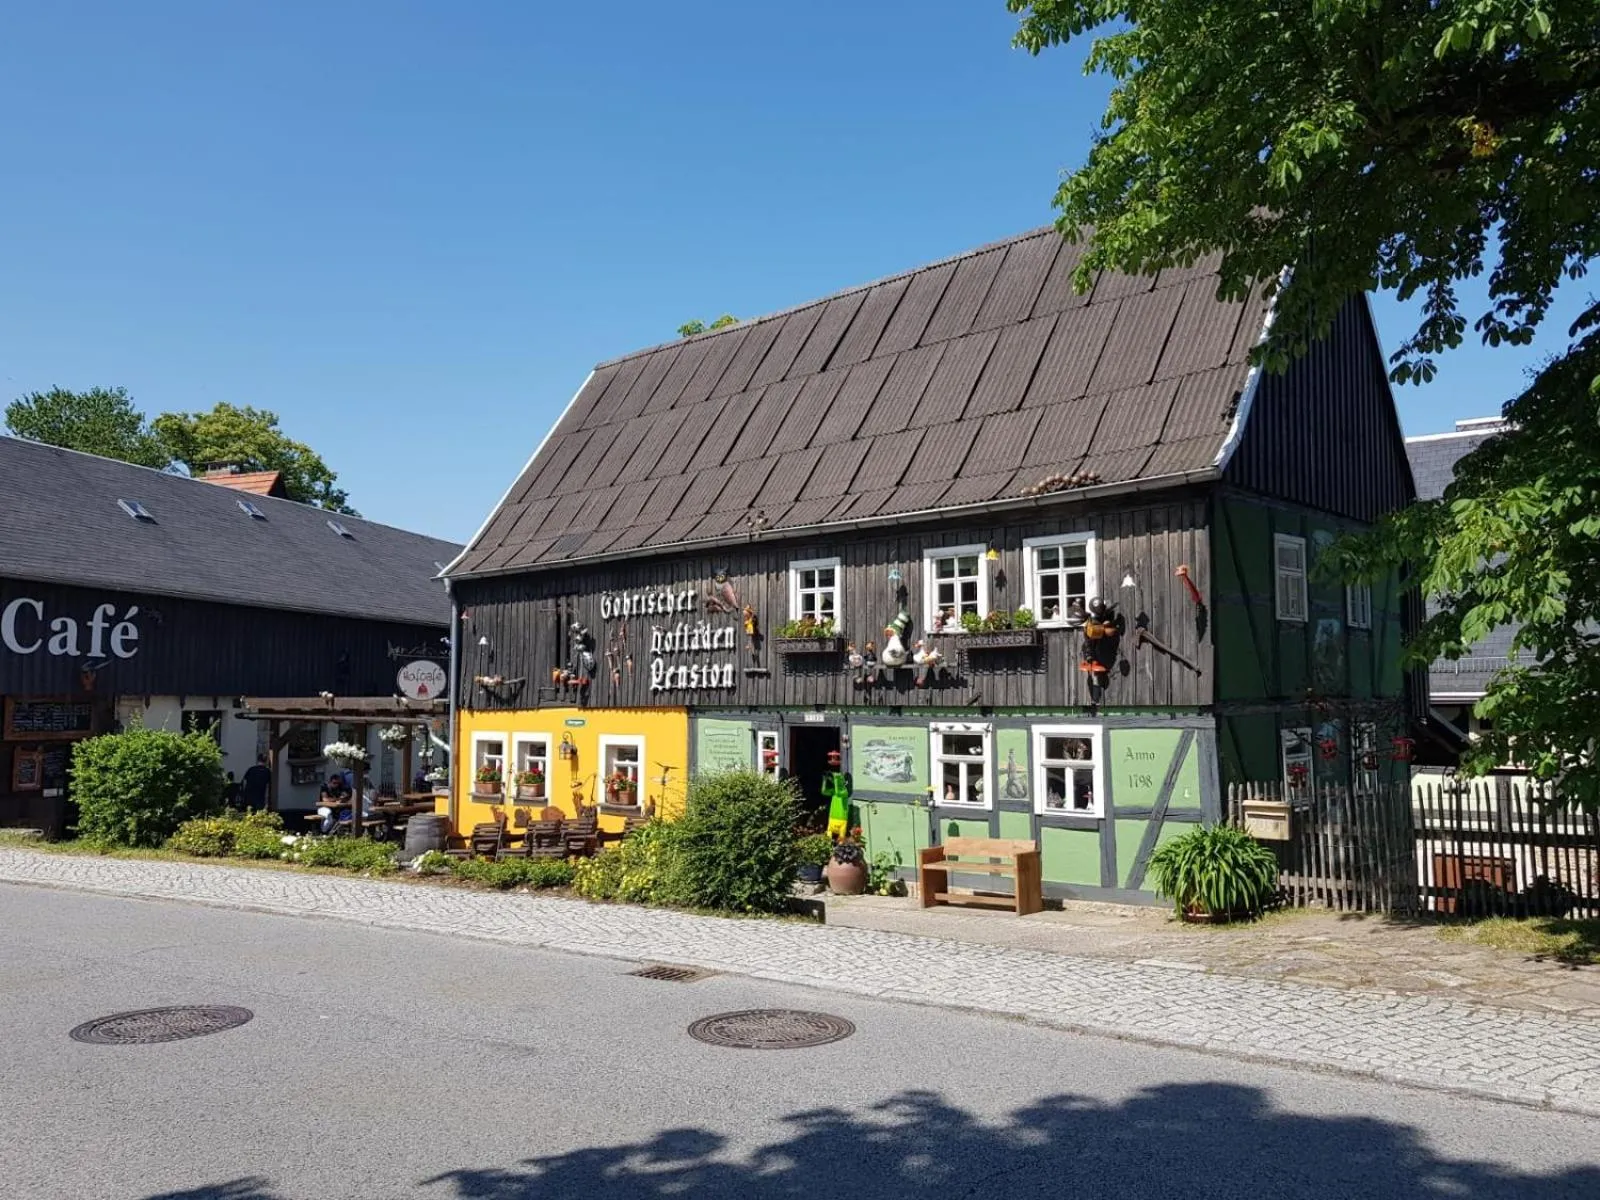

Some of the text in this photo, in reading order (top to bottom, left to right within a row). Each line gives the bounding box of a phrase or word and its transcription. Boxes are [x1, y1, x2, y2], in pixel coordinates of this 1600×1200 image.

[600, 586, 697, 621] Gohrischer
[1, 597, 139, 659] Café
[650, 657, 734, 691] Pension
[1123, 746, 1155, 764] Anno
[1128, 774, 1153, 789] 1798
